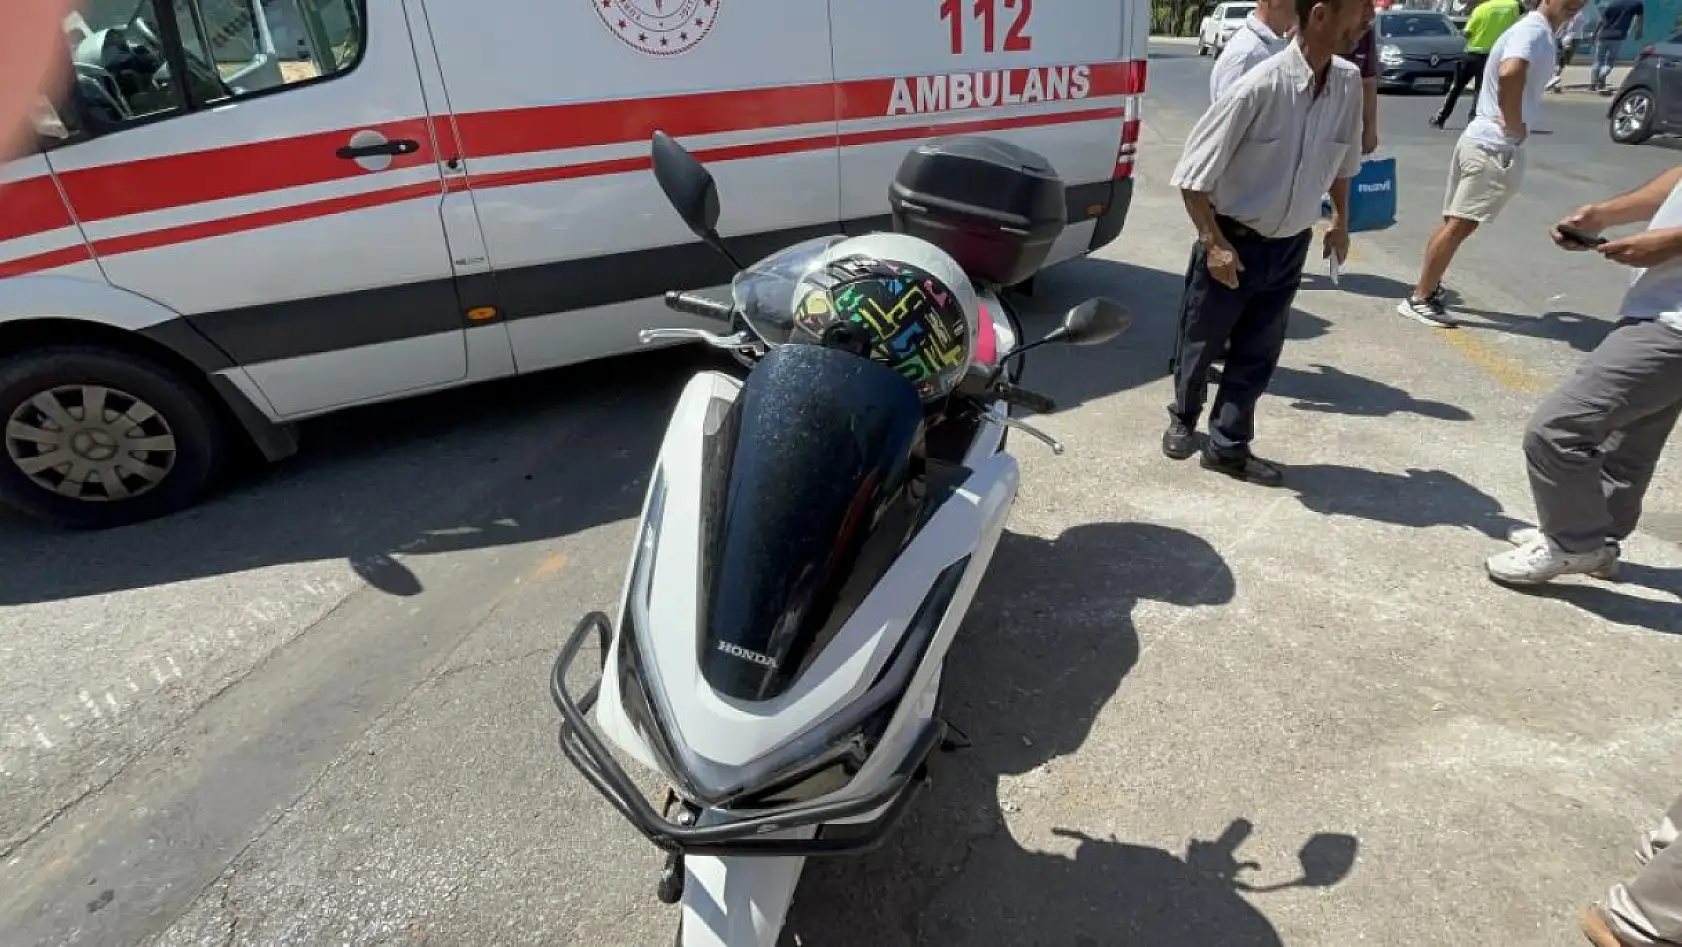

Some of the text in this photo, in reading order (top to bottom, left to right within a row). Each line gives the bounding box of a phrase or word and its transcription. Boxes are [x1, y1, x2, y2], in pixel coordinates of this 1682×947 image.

[940, 0, 1032, 54] 112
[887, 65, 1091, 116] AMBULANS
[1358, 180, 1391, 193] mavi
[717, 640, 779, 669] HONDA
